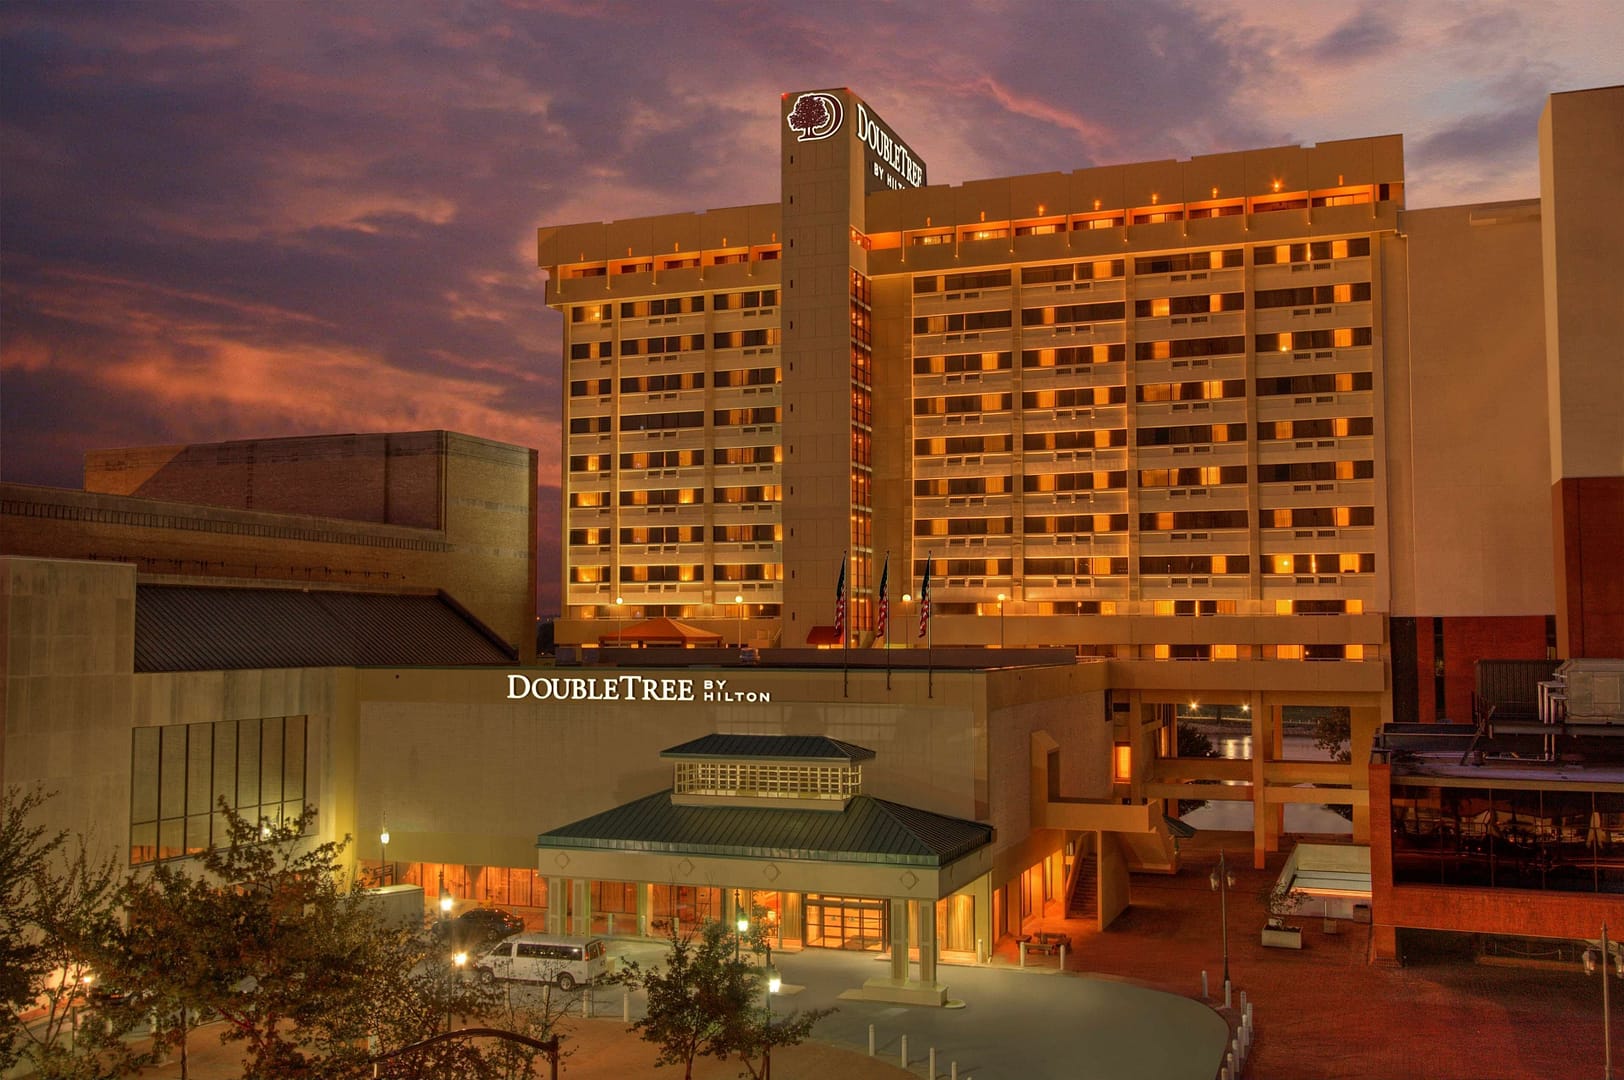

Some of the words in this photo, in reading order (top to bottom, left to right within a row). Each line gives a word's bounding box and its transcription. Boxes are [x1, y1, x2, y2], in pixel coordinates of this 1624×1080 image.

[857, 103, 922, 188] DOUBLETREE
[873, 162, 884, 180] BY
[507, 674, 695, 701] DOUBLETREE
[703, 679, 727, 690] BY
[703, 691, 770, 703] HILTON
